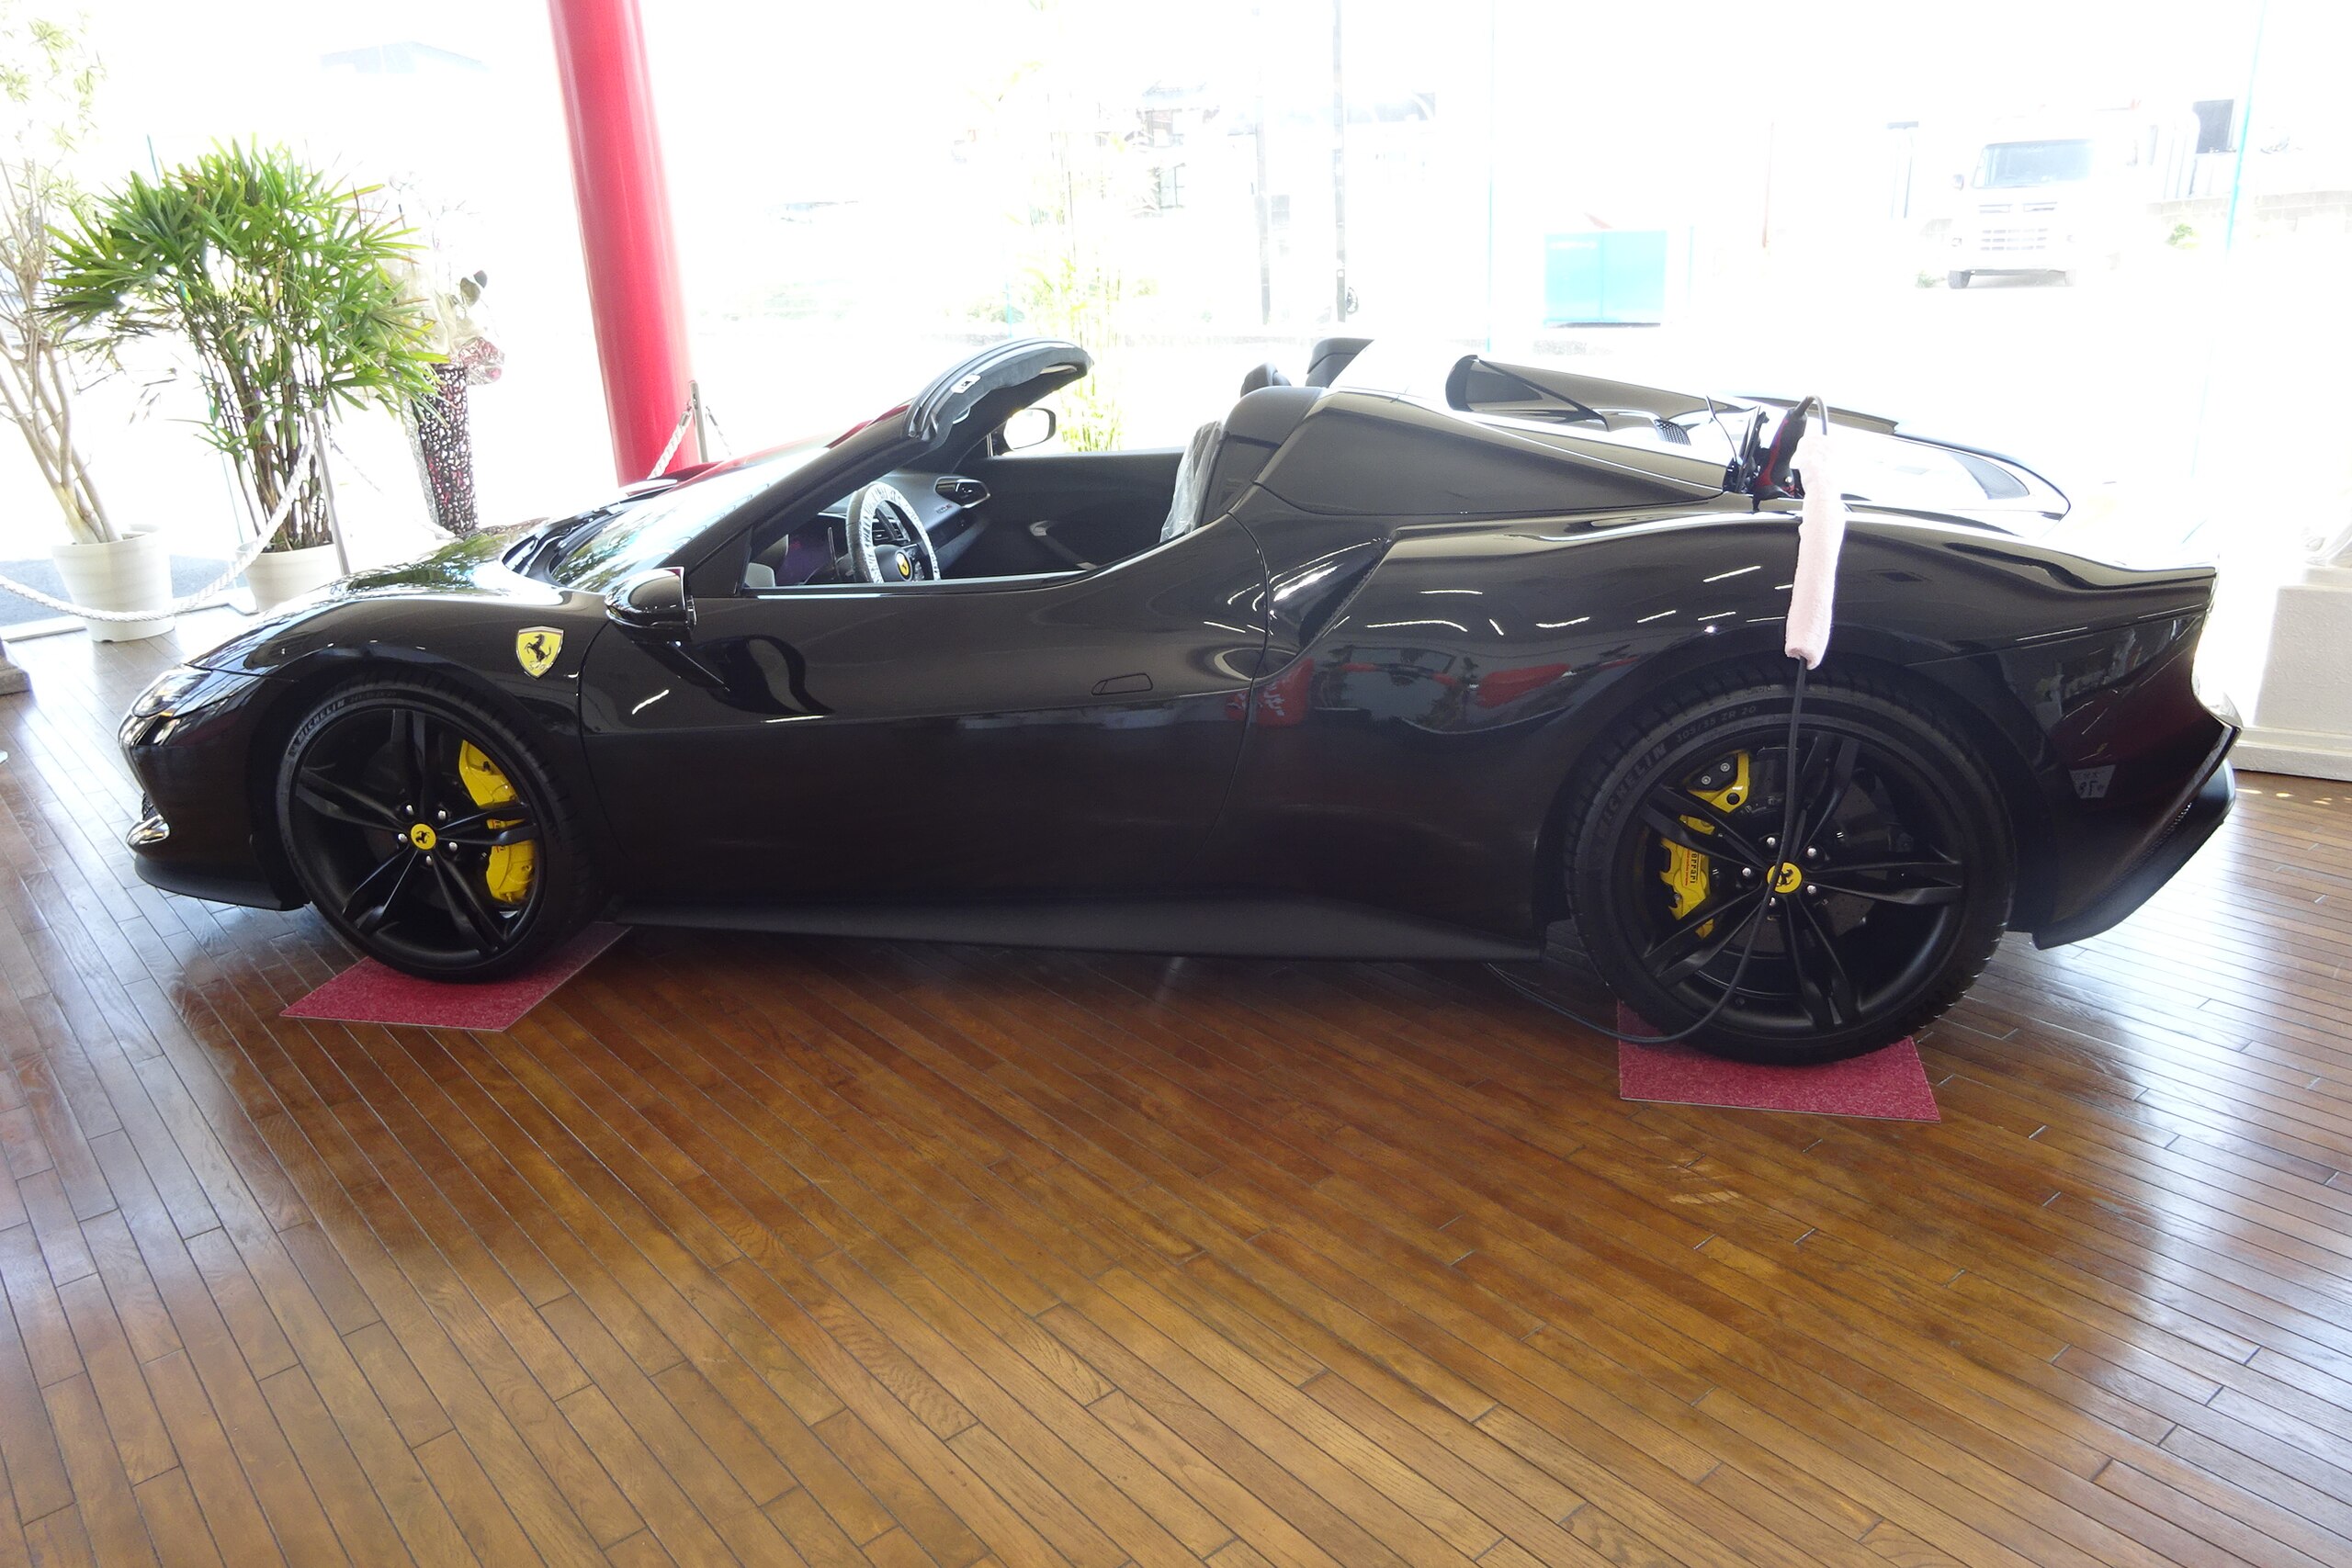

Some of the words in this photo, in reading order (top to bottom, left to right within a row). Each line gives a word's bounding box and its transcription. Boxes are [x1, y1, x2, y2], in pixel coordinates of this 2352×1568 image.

[297, 699, 345, 743] MICHELIN
[1599, 743, 1667, 832] ICHELIN
[1721, 710, 1736, 721] ZR
[1741, 705, 1757, 715] 20
[1690, 852, 1700, 884] errari
